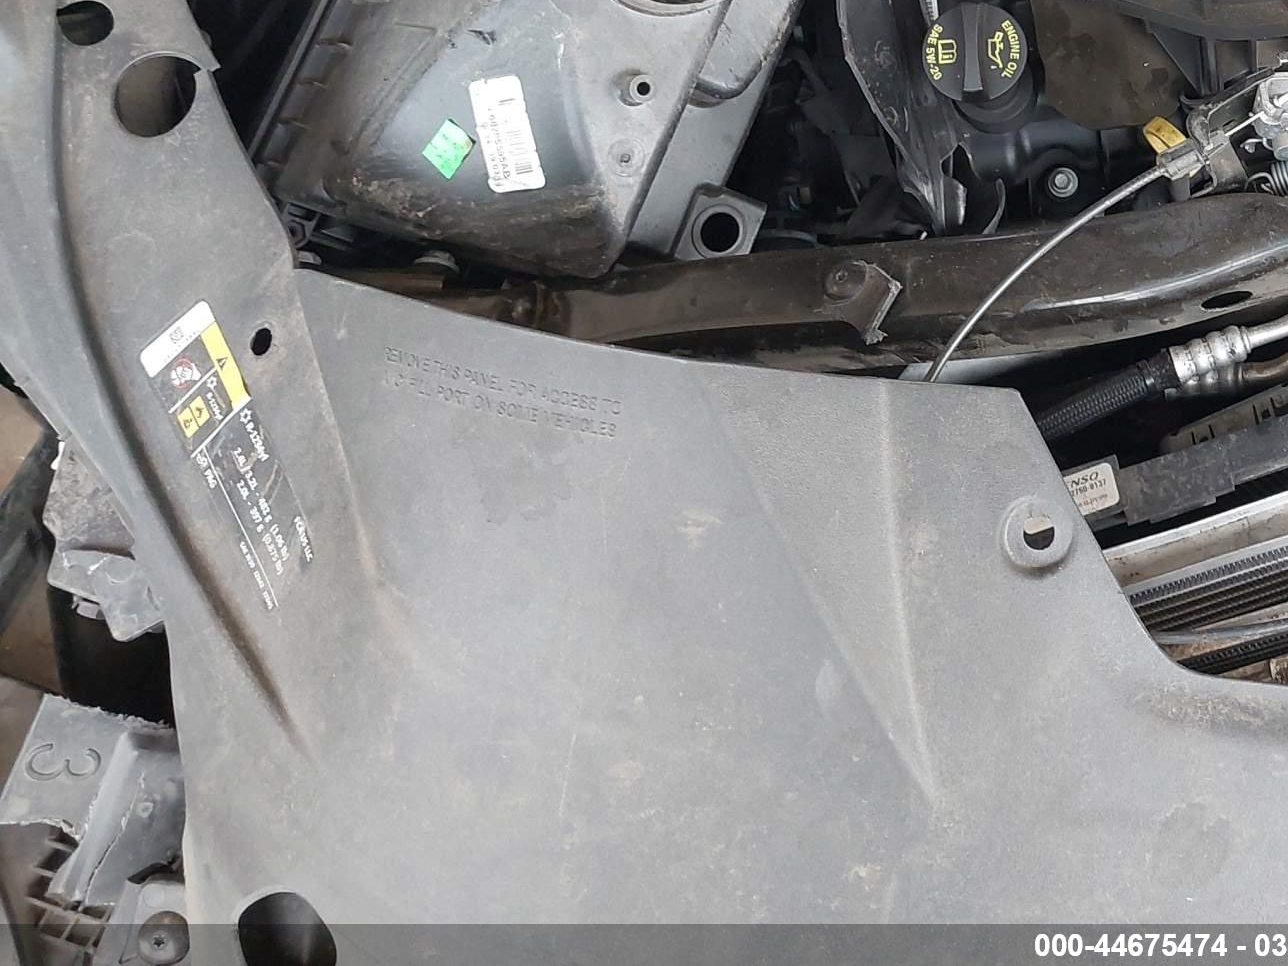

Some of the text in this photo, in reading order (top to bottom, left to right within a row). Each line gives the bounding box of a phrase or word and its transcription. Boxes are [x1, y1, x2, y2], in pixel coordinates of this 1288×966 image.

[926, 23, 943, 81] SAE 5W-20
[1001, 19, 1020, 78] ENGINE OIL
[542, 386, 597, 411] ACCESS
[1070, 471, 1098, 488] NSO
